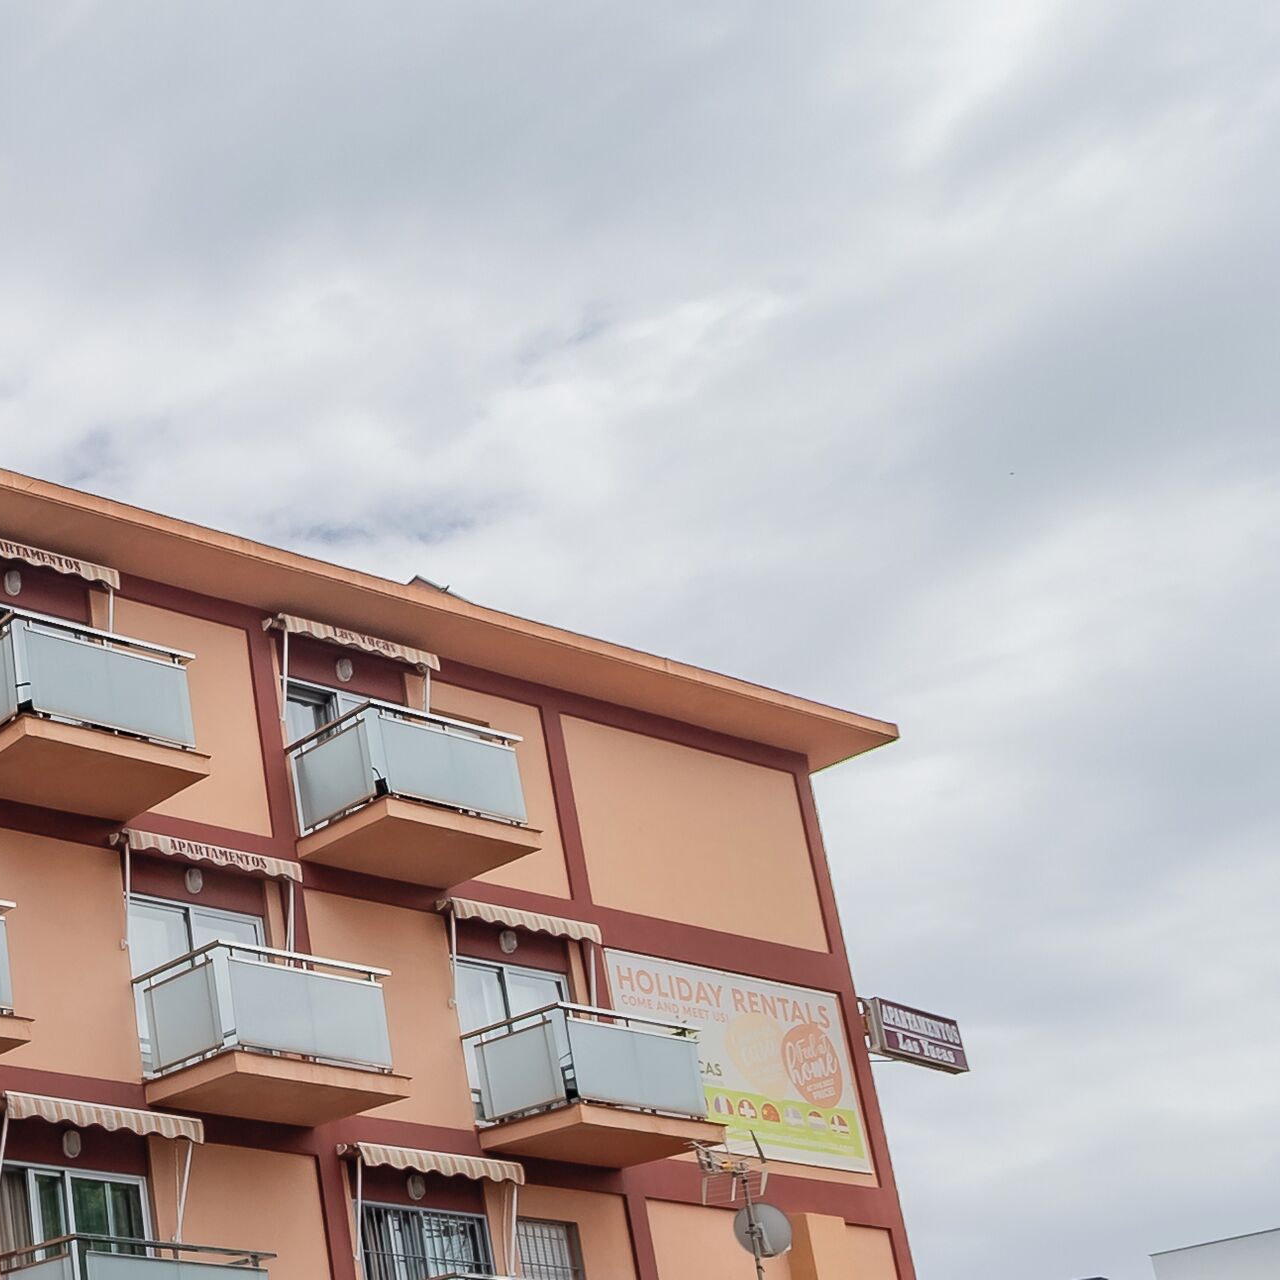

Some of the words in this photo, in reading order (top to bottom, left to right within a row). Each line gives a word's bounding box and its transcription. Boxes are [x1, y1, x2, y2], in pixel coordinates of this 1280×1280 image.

[170, 838, 267, 869] APARTAMENTOS
[616, 965, 722, 1008] HOLIDAY
[732, 988, 830, 1028] RENTALS
[621, 994, 653, 1009] COME
[657, 999, 679, 1014] AND
[682, 1005, 709, 1019] MEET
[882, 1004, 960, 1044] APARTAMENTOS
[897, 1032, 920, 1053] Las
[919, 1039, 955, 1063] Yucas
